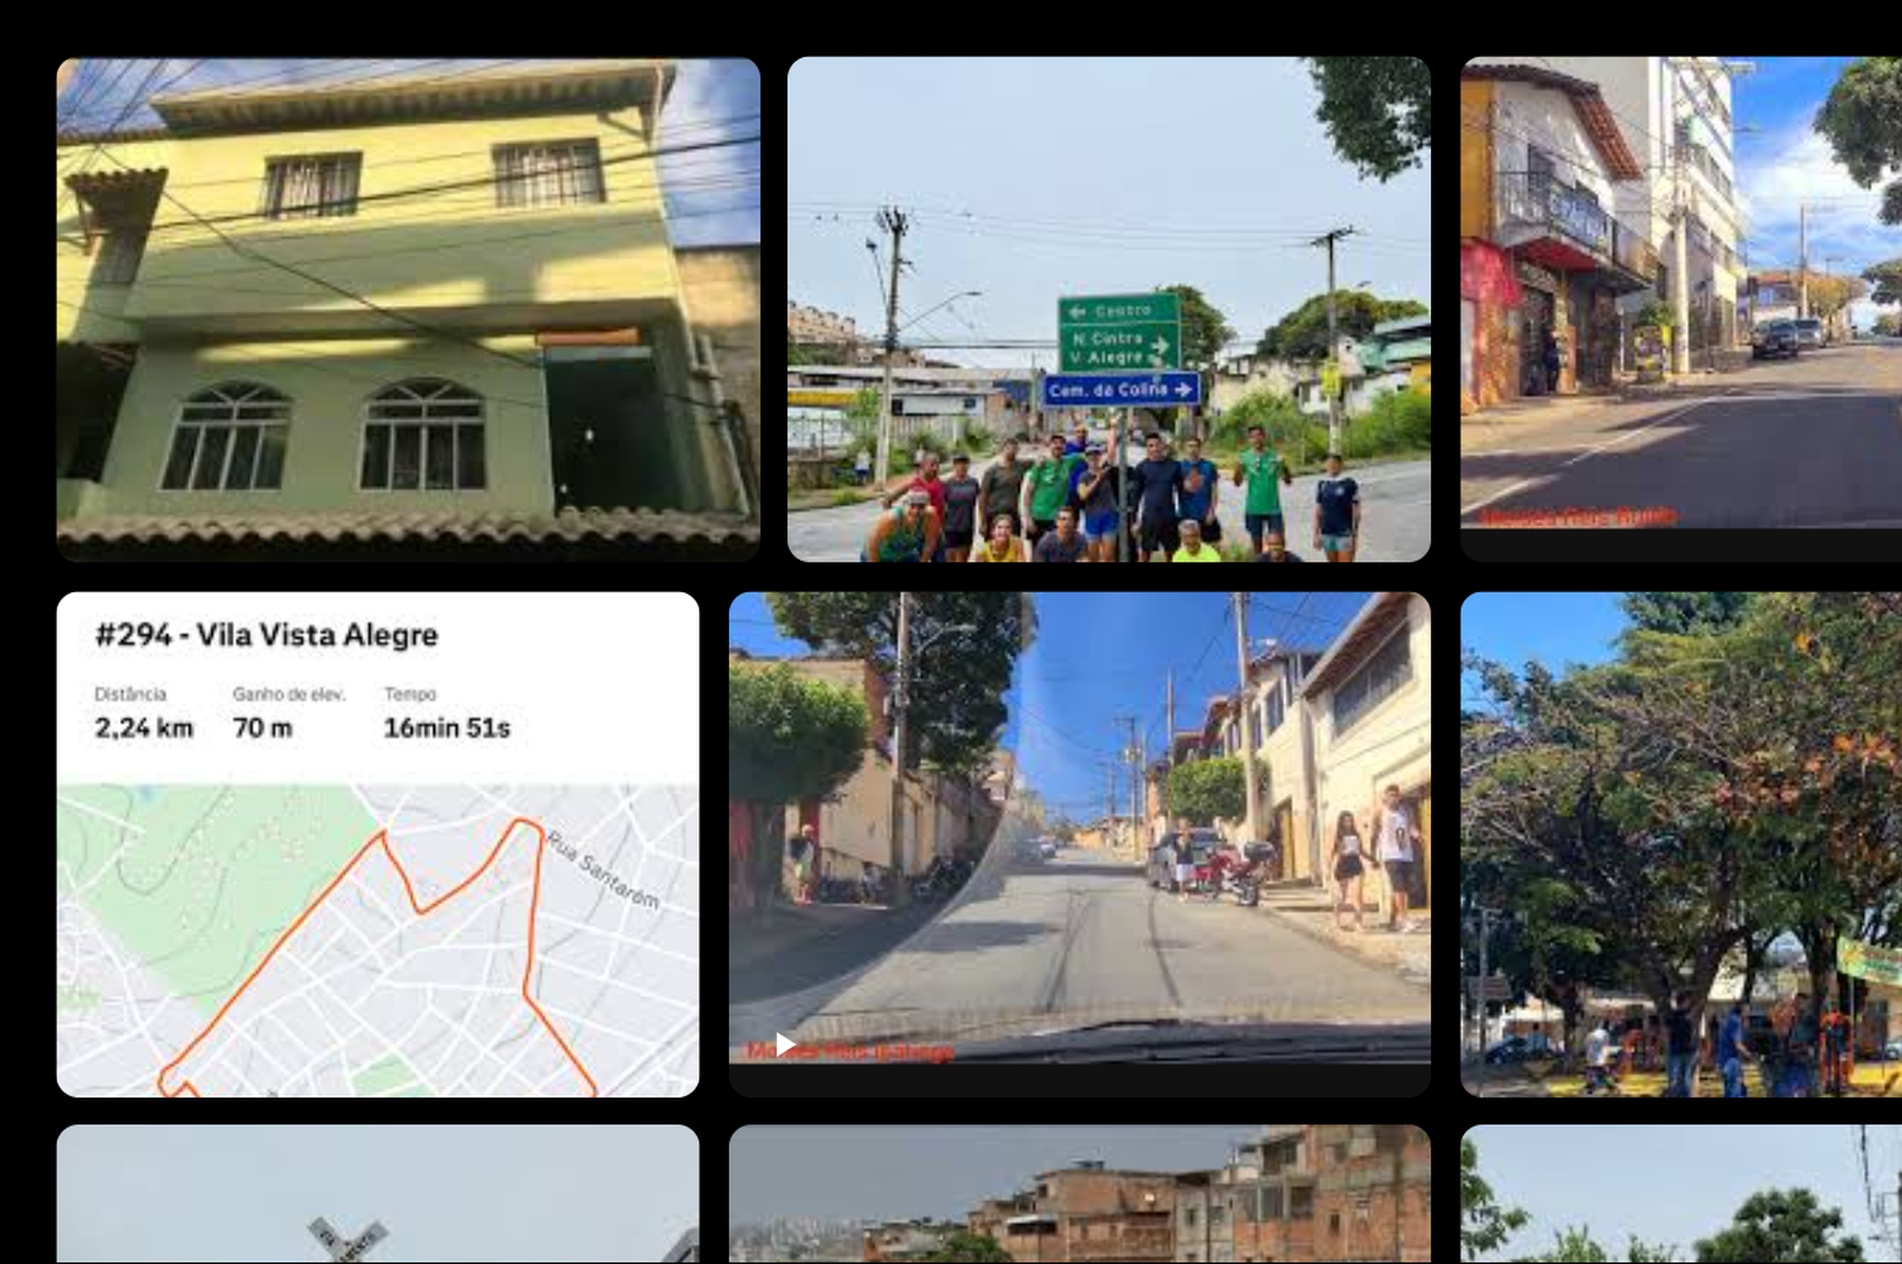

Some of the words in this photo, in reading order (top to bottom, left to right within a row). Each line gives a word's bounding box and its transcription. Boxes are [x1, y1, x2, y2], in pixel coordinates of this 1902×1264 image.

[1096, 304, 1150, 318] Centro
[1087, 351, 1142, 366] Alegre
[95, 622, 172, 647] #294
[196, 622, 253, 647] Vila
[260, 622, 336, 647] Vista
[343, 622, 439, 652] Alegre
[94, 686, 167, 702] Distância
[232, 686, 285, 702] Ganho
[288, 687, 308, 702] de
[310, 687, 347, 702] elev.
[384, 686, 437, 704] Tempo
[95, 717, 150, 740] 2,24
[157, 717, 194, 738] km
[232, 717, 265, 738] 70
[271, 722, 293, 738] m
[385, 717, 460, 738] 16min
[466, 717, 511, 738] 51s
[547, 830, 577, 862] Rua
